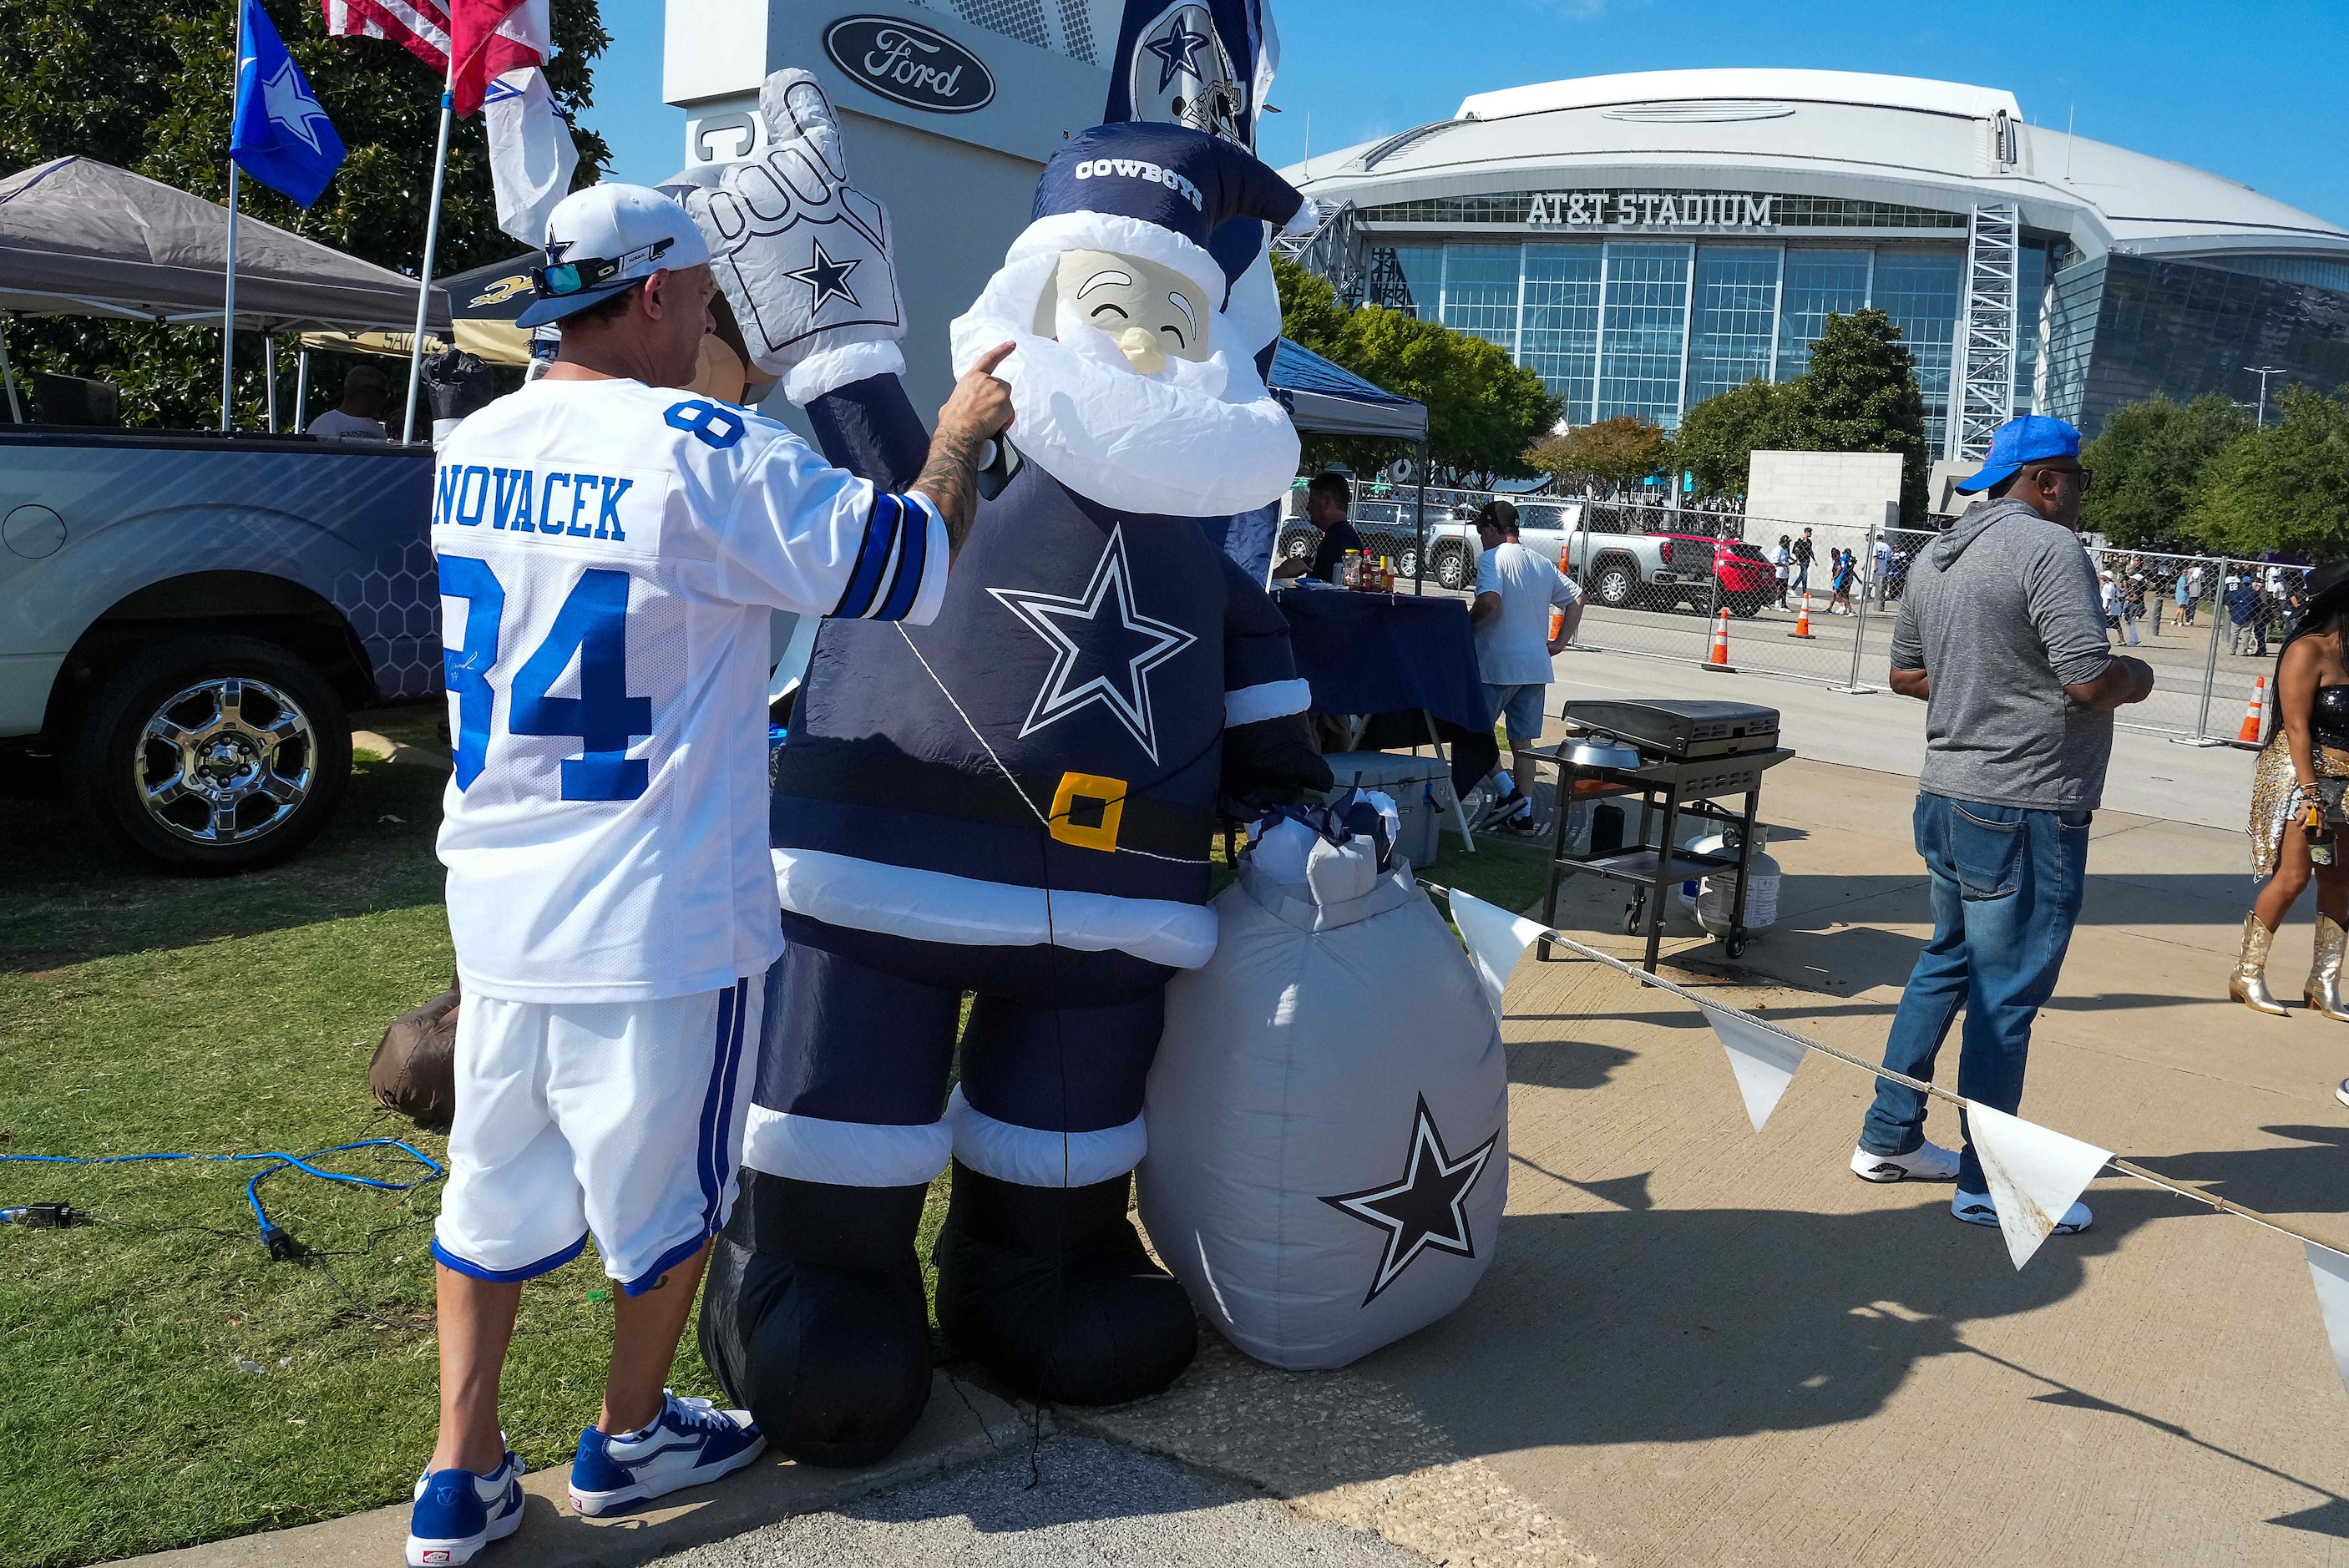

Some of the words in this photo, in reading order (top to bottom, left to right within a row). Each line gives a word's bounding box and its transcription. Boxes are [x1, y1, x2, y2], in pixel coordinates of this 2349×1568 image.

[863, 29, 963, 97] Ford
[1075, 159, 1202, 212] COWBOYS
[1526, 193, 1610, 225] AT&T
[1618, 194, 1773, 226] STADIUM
[433, 464, 634, 542] NOVACEK
[438, 553, 652, 802] 84
